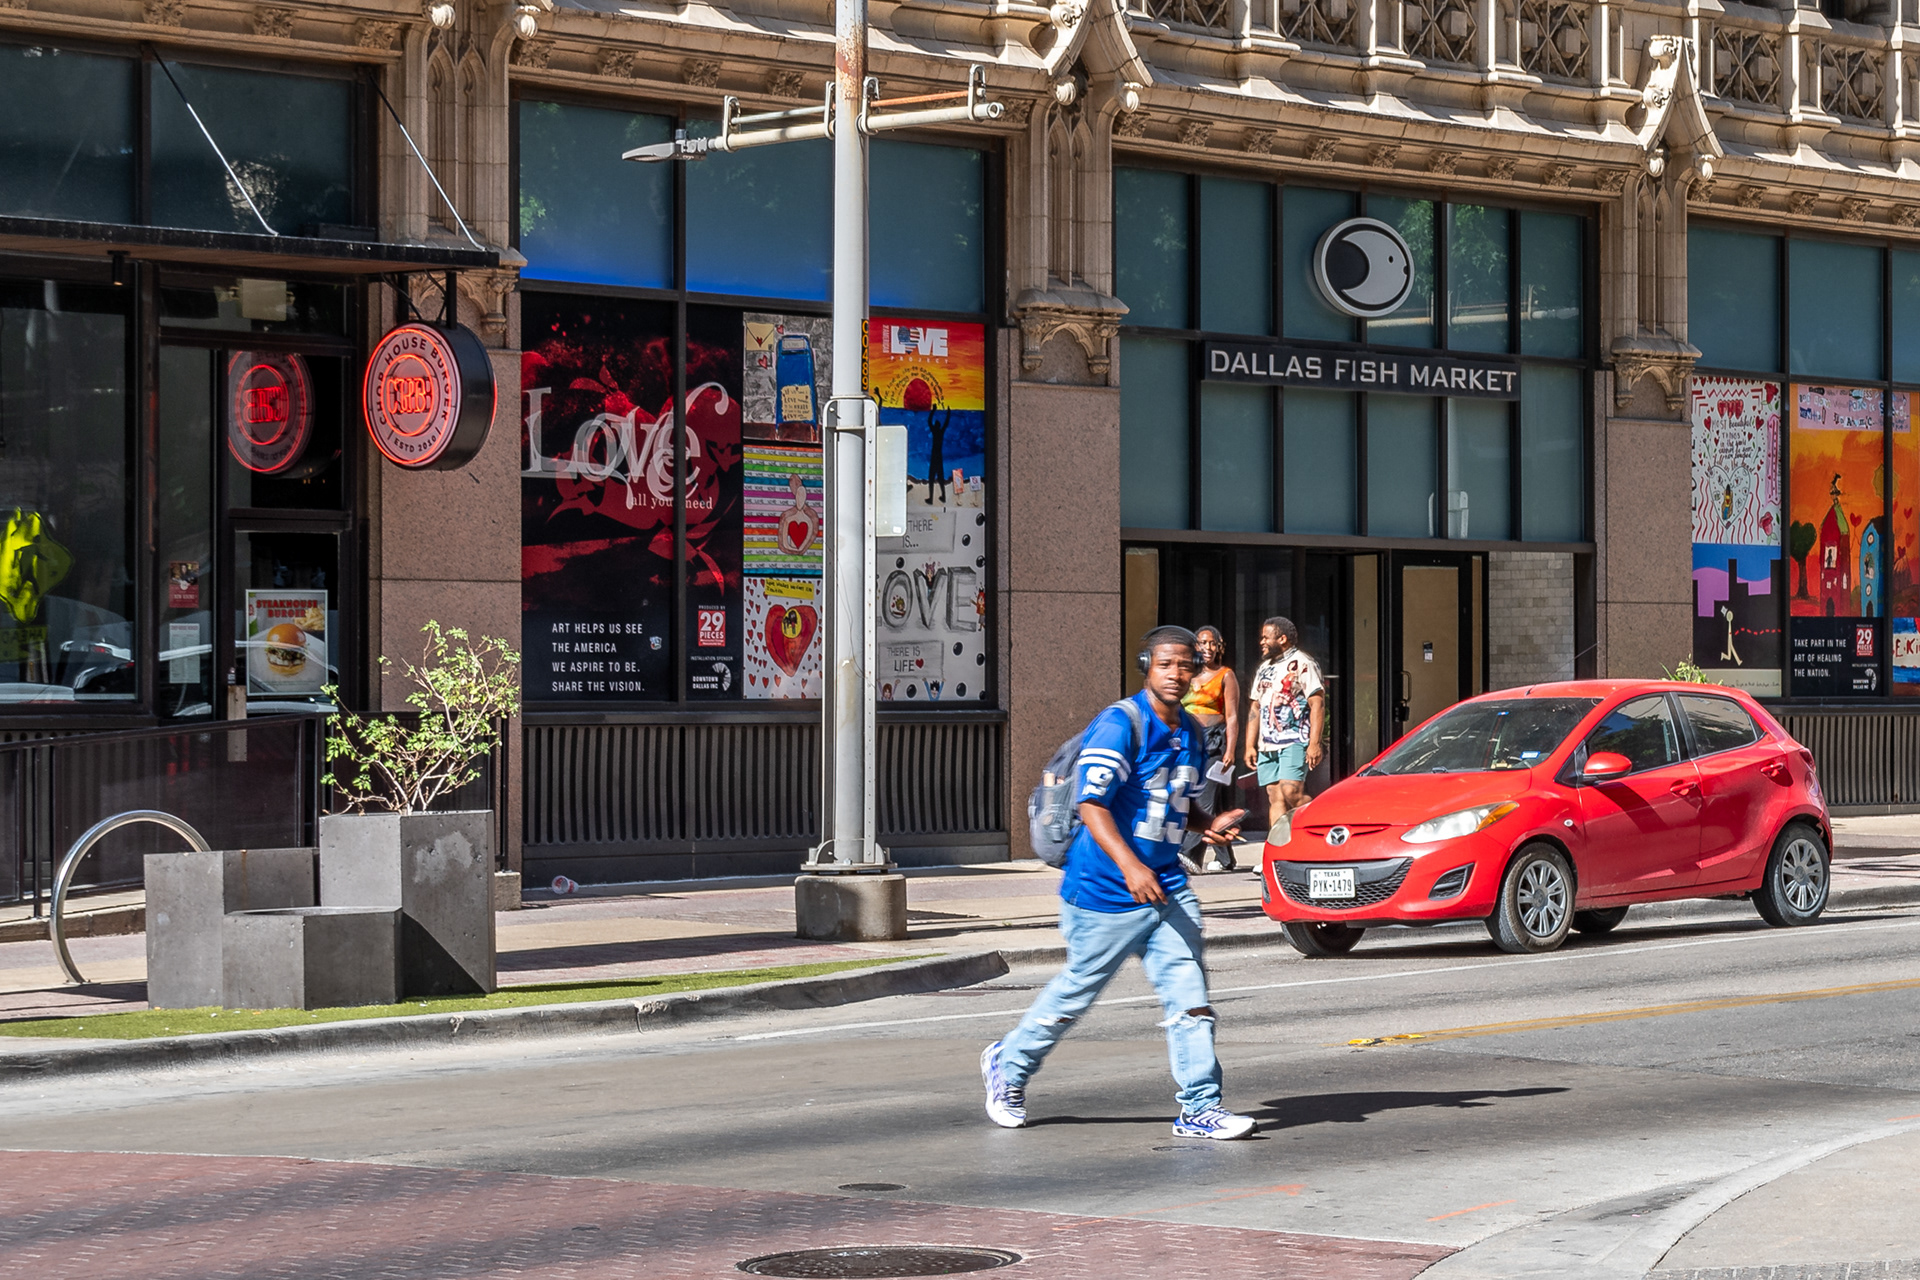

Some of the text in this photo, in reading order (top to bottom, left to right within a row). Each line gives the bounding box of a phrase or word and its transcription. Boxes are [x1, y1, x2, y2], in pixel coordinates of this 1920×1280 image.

[861, 320, 870, 391] 00489
[890, 356, 948, 364] PROJECT
[1211, 350, 1517, 392] DALLAS FISH MARKET
[384, 337, 427, 366] HOUSE
[430, 347, 452, 421] BURGER
[394, 435, 437, 452] ESTD 2010
[632, 493, 713, 510] all you need
[908, 519, 933, 532] THERE
[256, 600, 318, 608] STEAKHOUSE
[876, 567, 977, 632] OVE
[268, 609, 306, 618] BURGER
[700, 612, 724, 631] 29
[552, 623, 642, 634] ART HELPS US SEE
[1858, 629, 1872, 644] 29
[552, 642, 617, 653] THE AMERICA
[1794, 639, 1846, 648] TAKE PART IN THE
[886, 645, 920, 657] THERE IS
[1794, 654, 1842, 662] ART OF HEALING
[552, 662, 640, 672] WE ASPIRE TO BE.
[894, 660, 915, 672] LIFE
[1794, 669, 1831, 677] THE NATION.
[552, 682, 645, 692] SHARE THE VISION.
